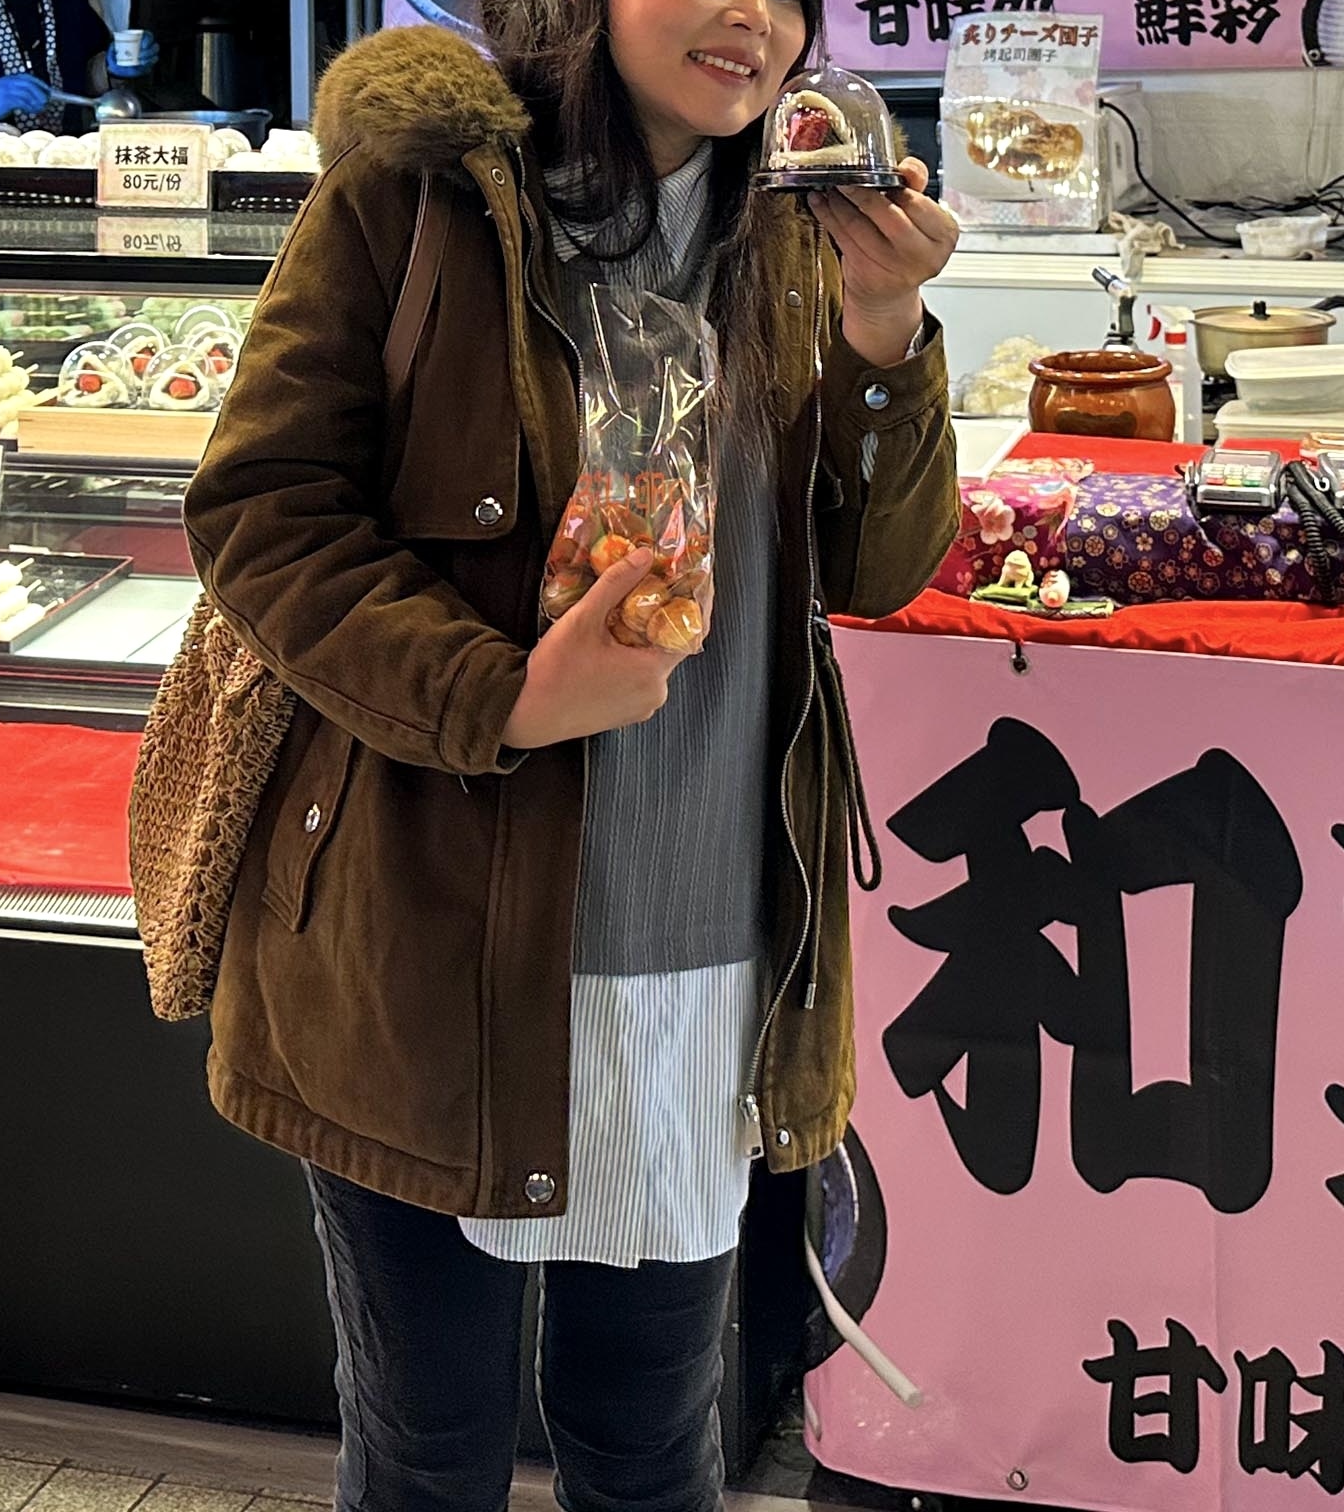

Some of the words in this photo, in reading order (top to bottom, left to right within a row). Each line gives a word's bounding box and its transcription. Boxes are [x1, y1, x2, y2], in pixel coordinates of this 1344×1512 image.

[961, 22, 1099, 48] 炙りチーズ団子
[114, 145, 190, 166] 抹茶大福
[122, 173, 182, 192] 80元/份
